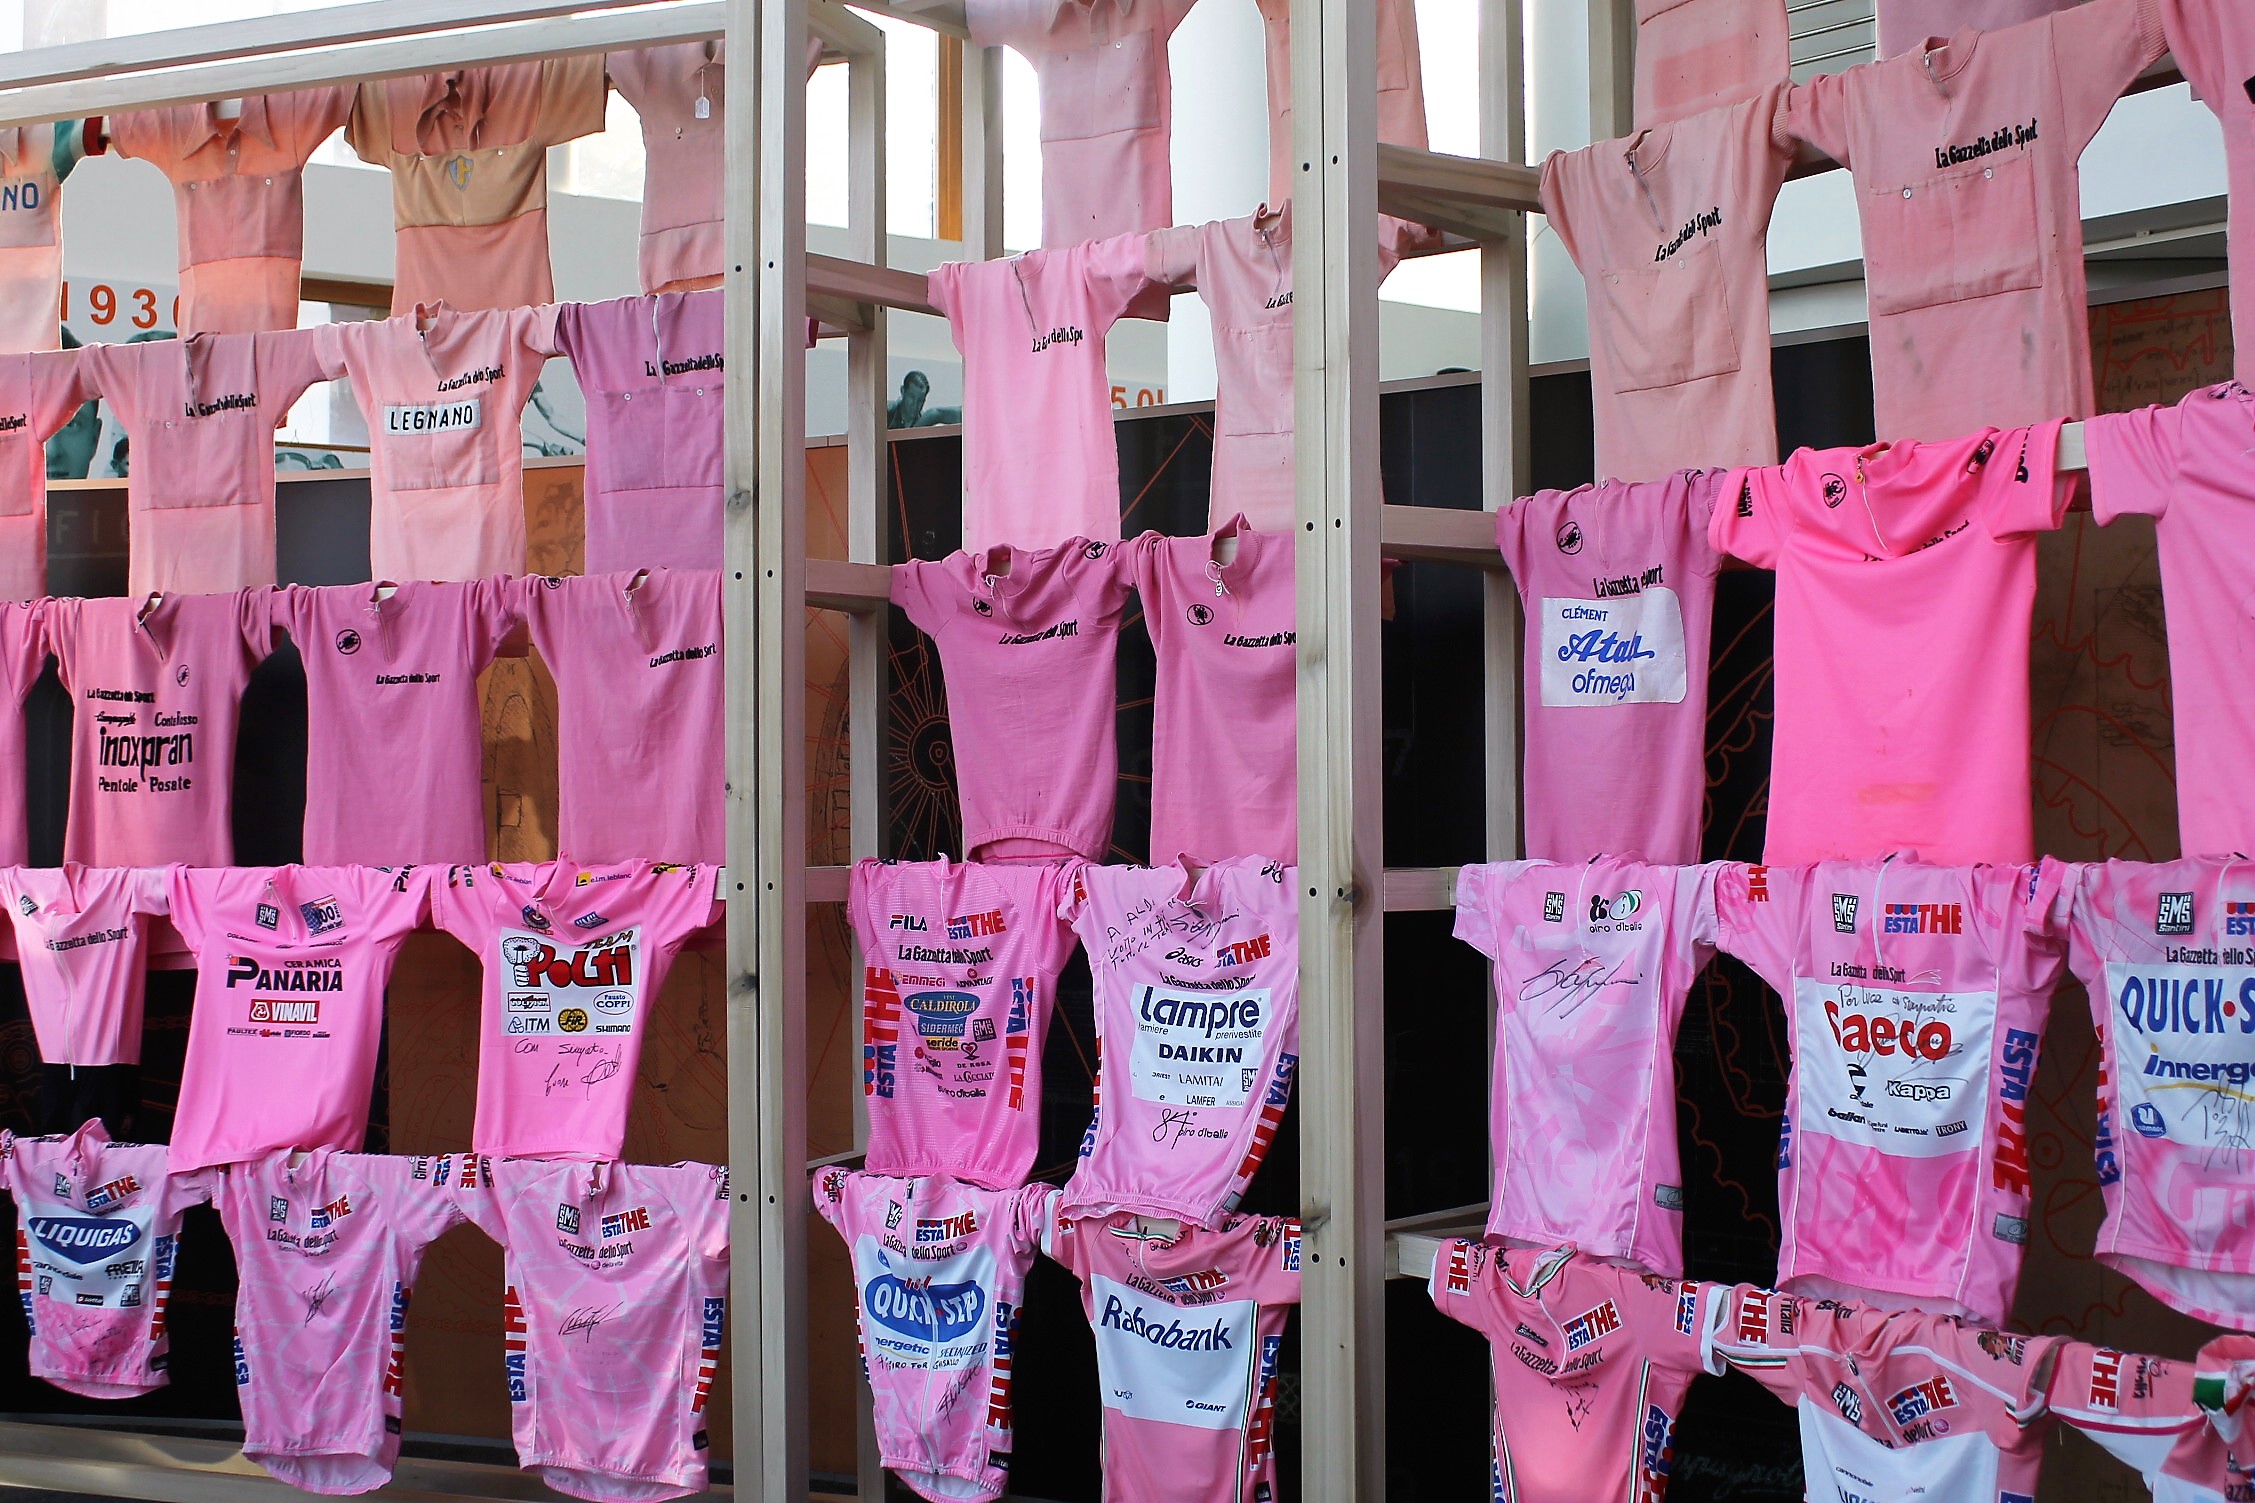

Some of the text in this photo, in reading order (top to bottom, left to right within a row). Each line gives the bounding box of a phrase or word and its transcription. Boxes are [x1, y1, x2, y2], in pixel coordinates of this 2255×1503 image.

[389, 404, 474, 431] LEGNANO
[99, 726, 193, 782] inoxpran
[98, 776, 138, 792] Pentole
[1545, 893, 1563, 914] SMS
[1834, 897, 1856, 923] SMS
[2158, 894, 2193, 924] SMS
[889, 914, 928, 932] FILA
[284, 958, 342, 968] CERAMICA
[965, 946, 994, 969] Sport
[2166, 946, 2178, 963] La
[2179, 946, 2218, 964] Gazzetta
[226, 955, 343, 992] PANARIA
[271, 1002, 318, 1022] VINAVIL
[596, 1000, 631, 1008] COPPI
[909, 998, 976, 1014] CALDIROLA
[525, 1018, 550, 1031] ITM
[595, 1024, 631, 1033] SHIMANO
[1159, 1043, 1243, 1063] DAIKIN
[1886, 1080, 1951, 1101] Kappa
[34, 1219, 134, 1248] LIQUIGAS
[1101, 1293, 1233, 1351] Rabobank
[1195, 1402, 1227, 1413] GIANT
